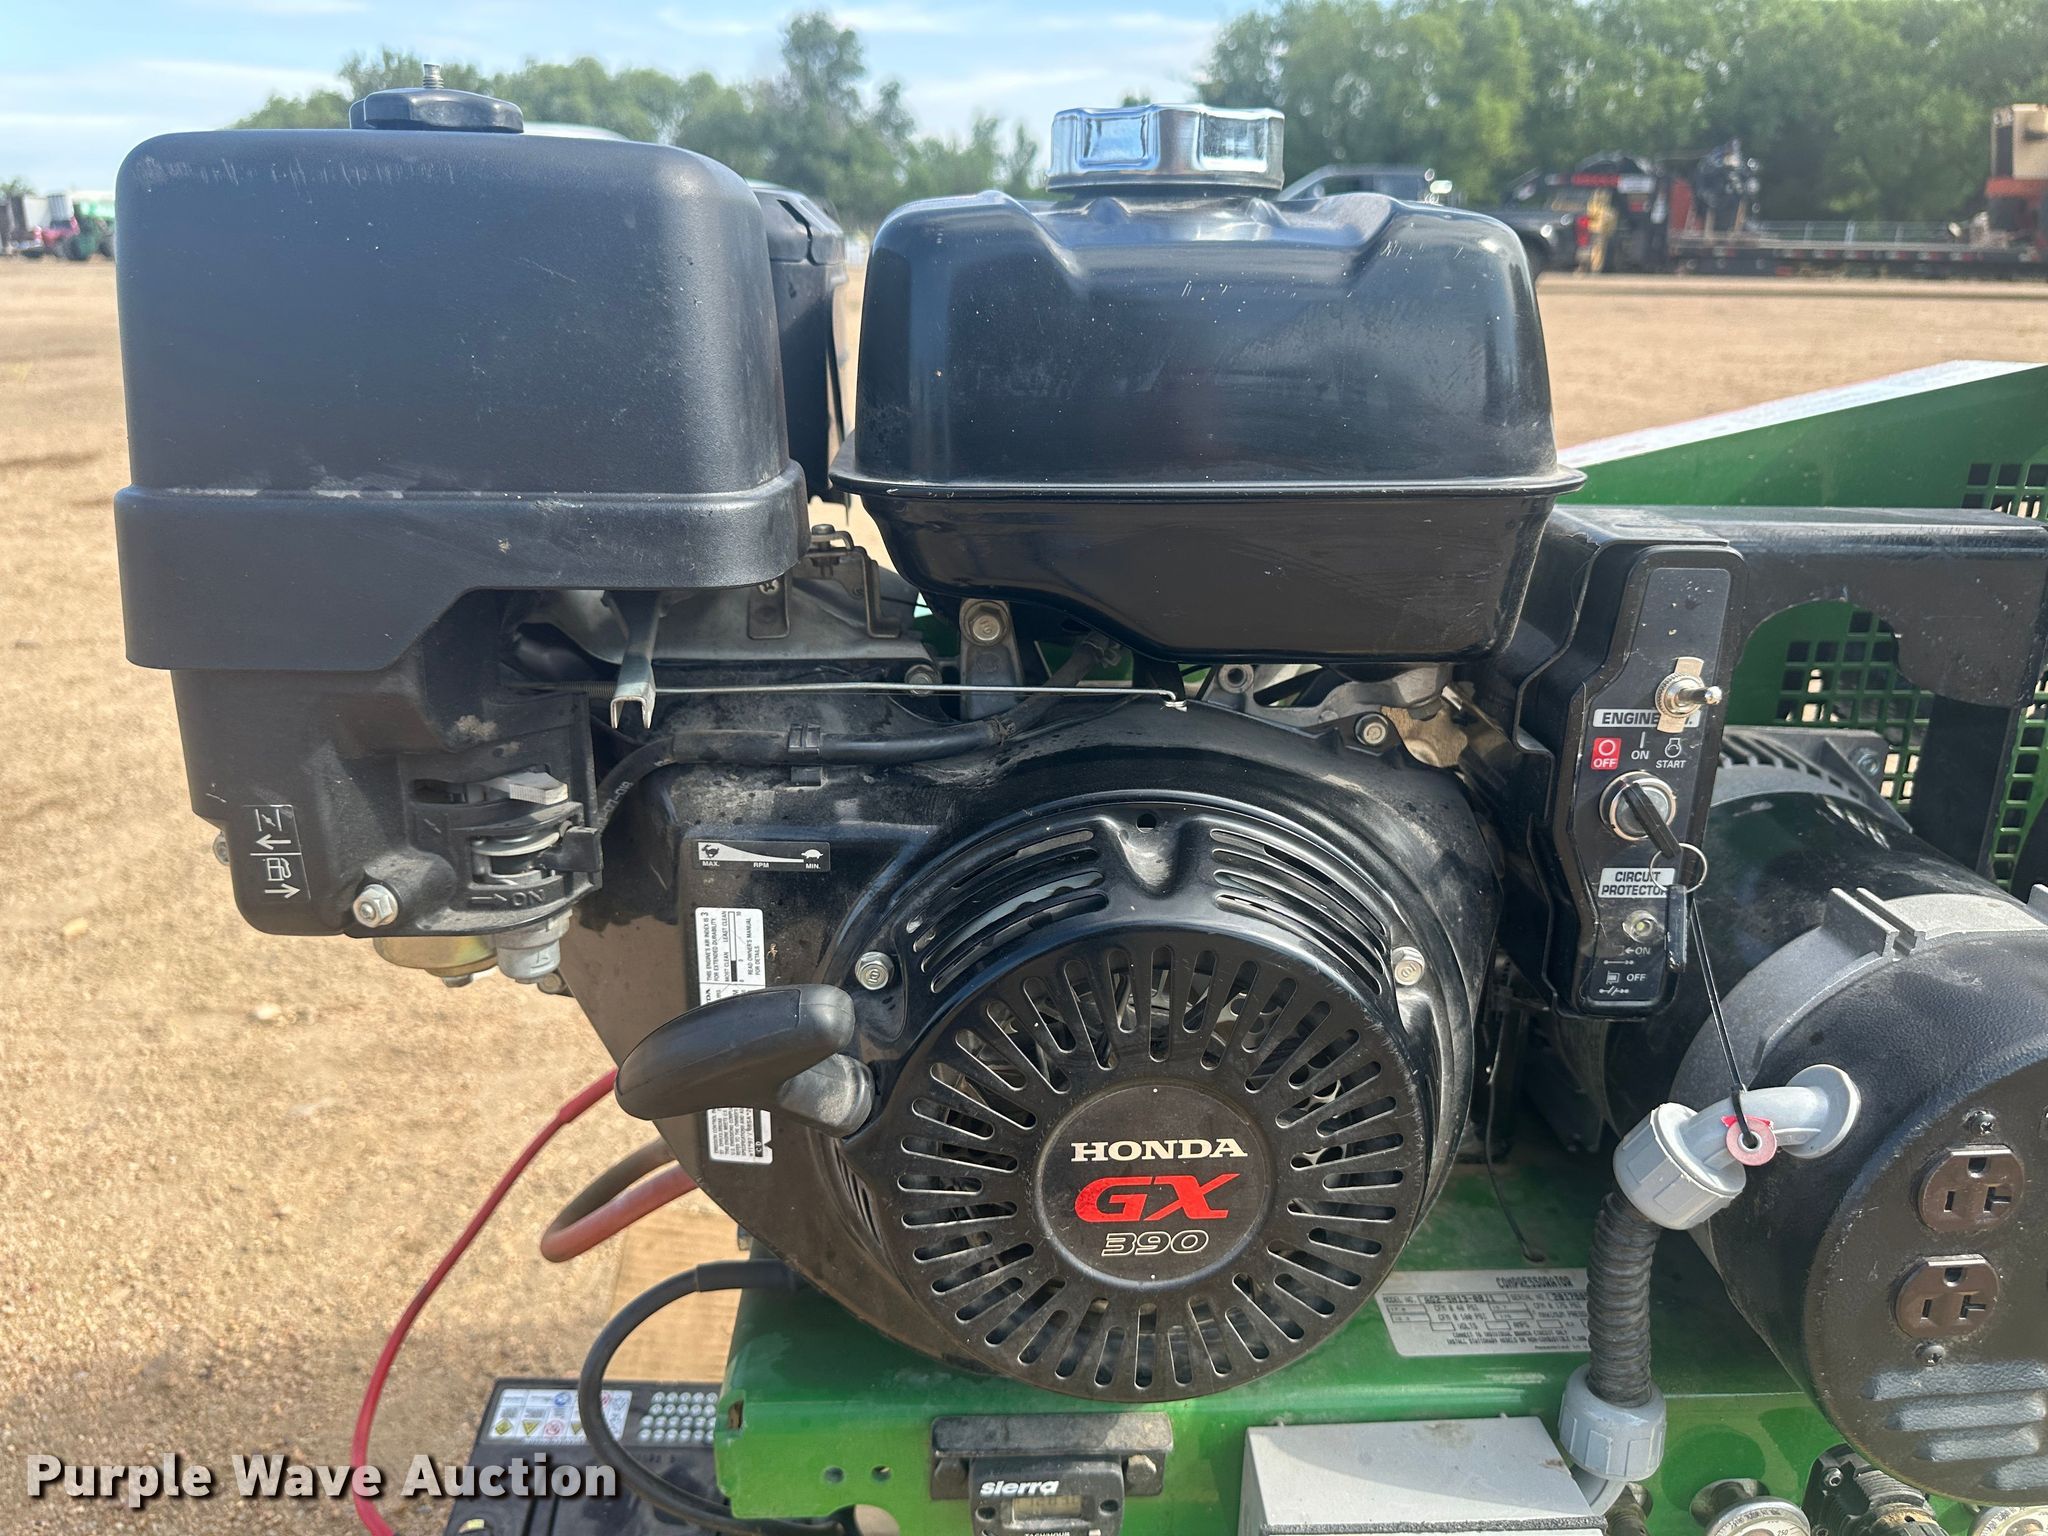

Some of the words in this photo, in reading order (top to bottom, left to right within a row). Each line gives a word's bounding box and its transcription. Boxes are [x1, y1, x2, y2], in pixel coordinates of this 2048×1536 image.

[1602, 712, 1660, 724] ENGINE
[1631, 750, 1650, 760] ON
[1594, 758, 1617, 768] OFF
[1656, 760, 1686, 768] START
[1615, 872, 1660, 882] CIRCUIT
[512, 889, 544, 906] ON
[1071, 1138, 1248, 1162] HONDA
[1074, 1174, 1240, 1222] GX
[1102, 1230, 1209, 1256] 390
[980, 1480, 1059, 1496] sierra
